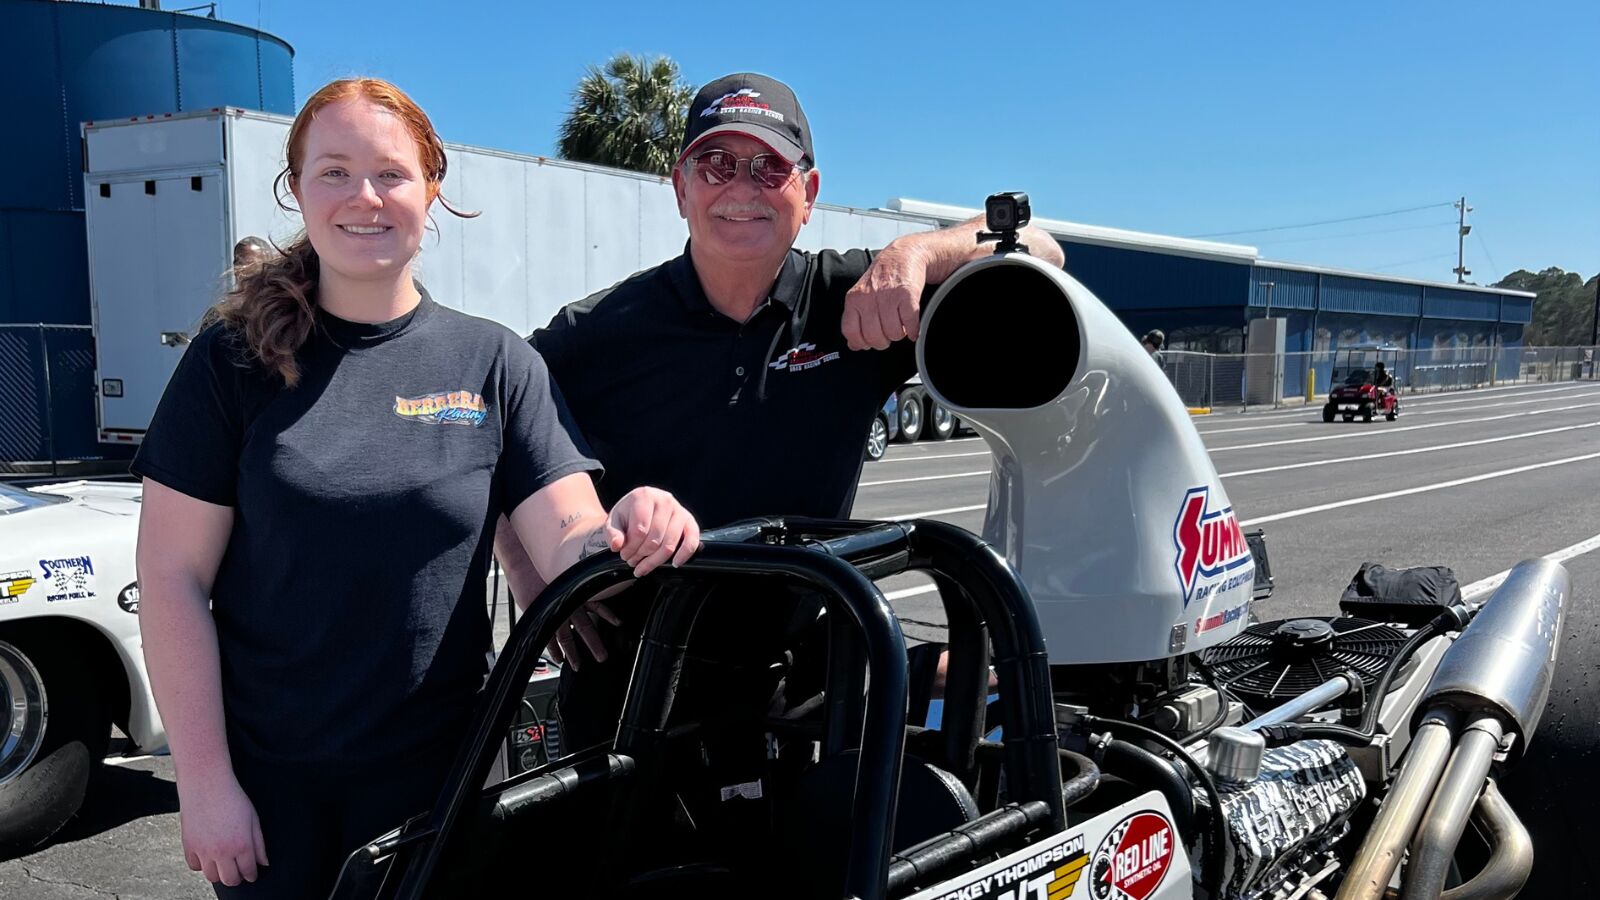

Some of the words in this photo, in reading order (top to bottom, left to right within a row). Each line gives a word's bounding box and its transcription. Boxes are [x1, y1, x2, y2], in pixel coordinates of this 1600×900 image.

[39, 555, 95, 580] SOUTHERN
[993, 835, 1084, 888] THOMPSON
[1115, 843, 1140, 883] RED
[1142, 827, 1169, 868] LINE
[1123, 865, 1152, 889] SYNTHETIC
[1152, 861, 1162, 872] OIL
